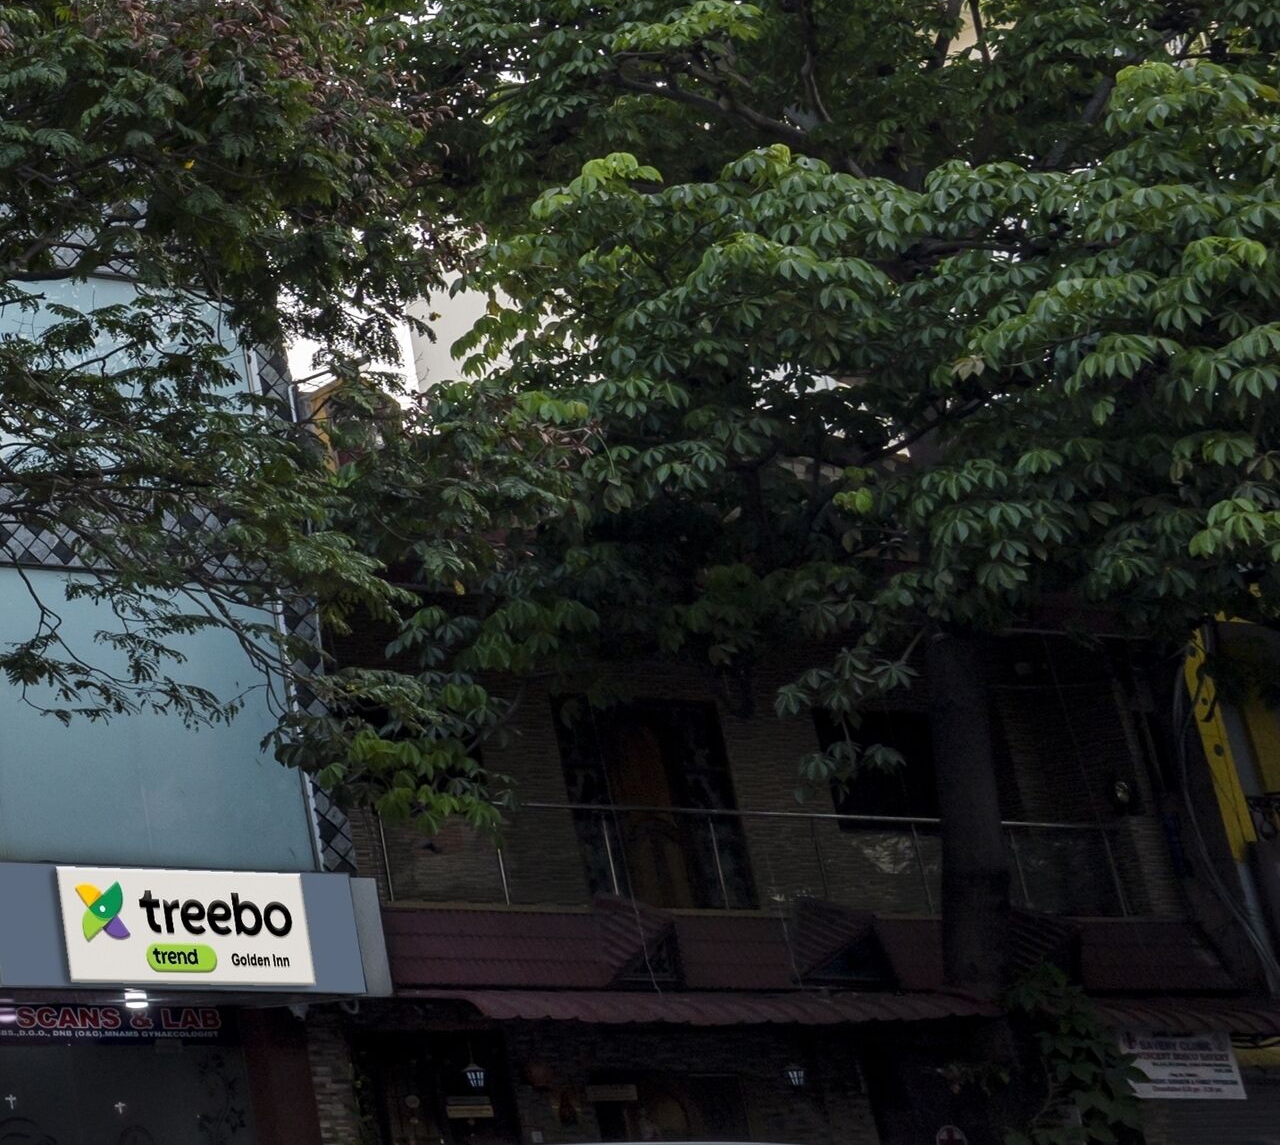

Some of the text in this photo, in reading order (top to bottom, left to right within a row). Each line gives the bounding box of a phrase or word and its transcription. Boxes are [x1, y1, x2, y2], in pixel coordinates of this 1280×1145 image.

[139, 890, 293, 938] treebo
[153, 947, 199, 965] trend
[231, 953, 291, 967] Golden Inn
[16, 1006, 121, 1029] SCANS
[131, 1008, 153, 1029] &
[161, 1008, 221, 1030] LAB
